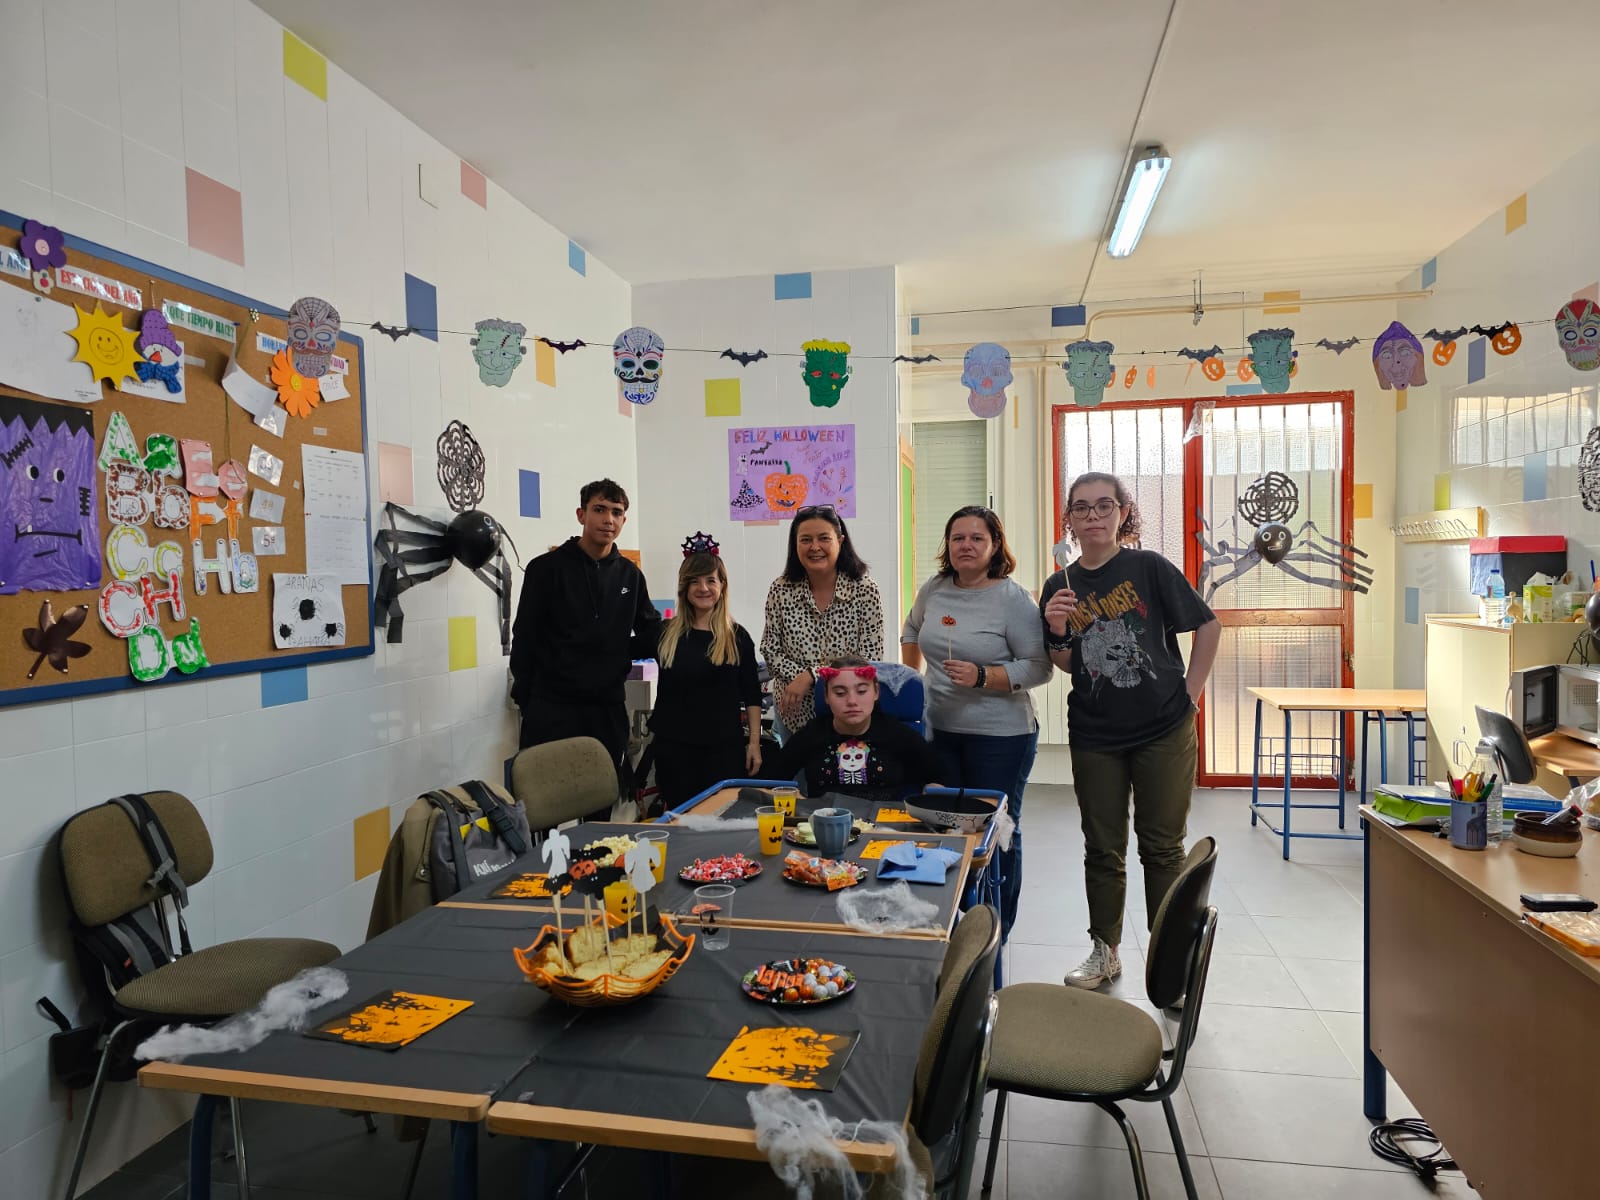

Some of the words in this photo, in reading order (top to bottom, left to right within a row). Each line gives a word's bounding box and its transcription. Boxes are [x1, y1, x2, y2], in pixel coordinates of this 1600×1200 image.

[188, 312, 213, 330] TIEMPO
[735, 430, 767, 444] FELIZ
[774, 430, 845, 443] HALLOWEEN
[1099, 581, 1139, 620] ROSES
